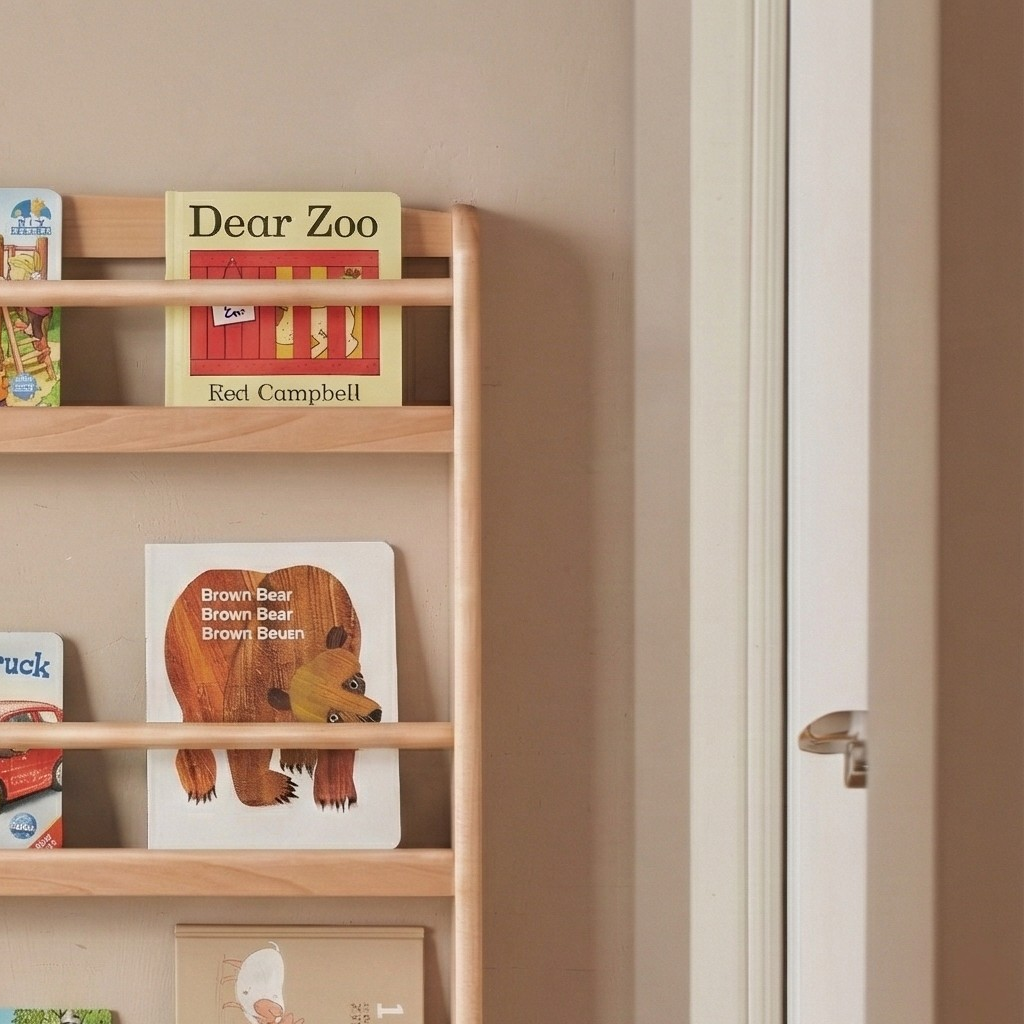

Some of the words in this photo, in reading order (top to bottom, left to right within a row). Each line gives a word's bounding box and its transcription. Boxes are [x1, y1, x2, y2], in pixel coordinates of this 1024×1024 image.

[189, 205, 292, 238] Dear
[306, 205, 378, 238] Zoo
[258, 383, 360, 405] Campbell
[201, 588, 252, 602] Brown
[256, 588, 292, 602] Bear
[201, 607, 252, 621] Brown
[257, 607, 293, 621] Bear
[202, 626, 252, 640] Brown
